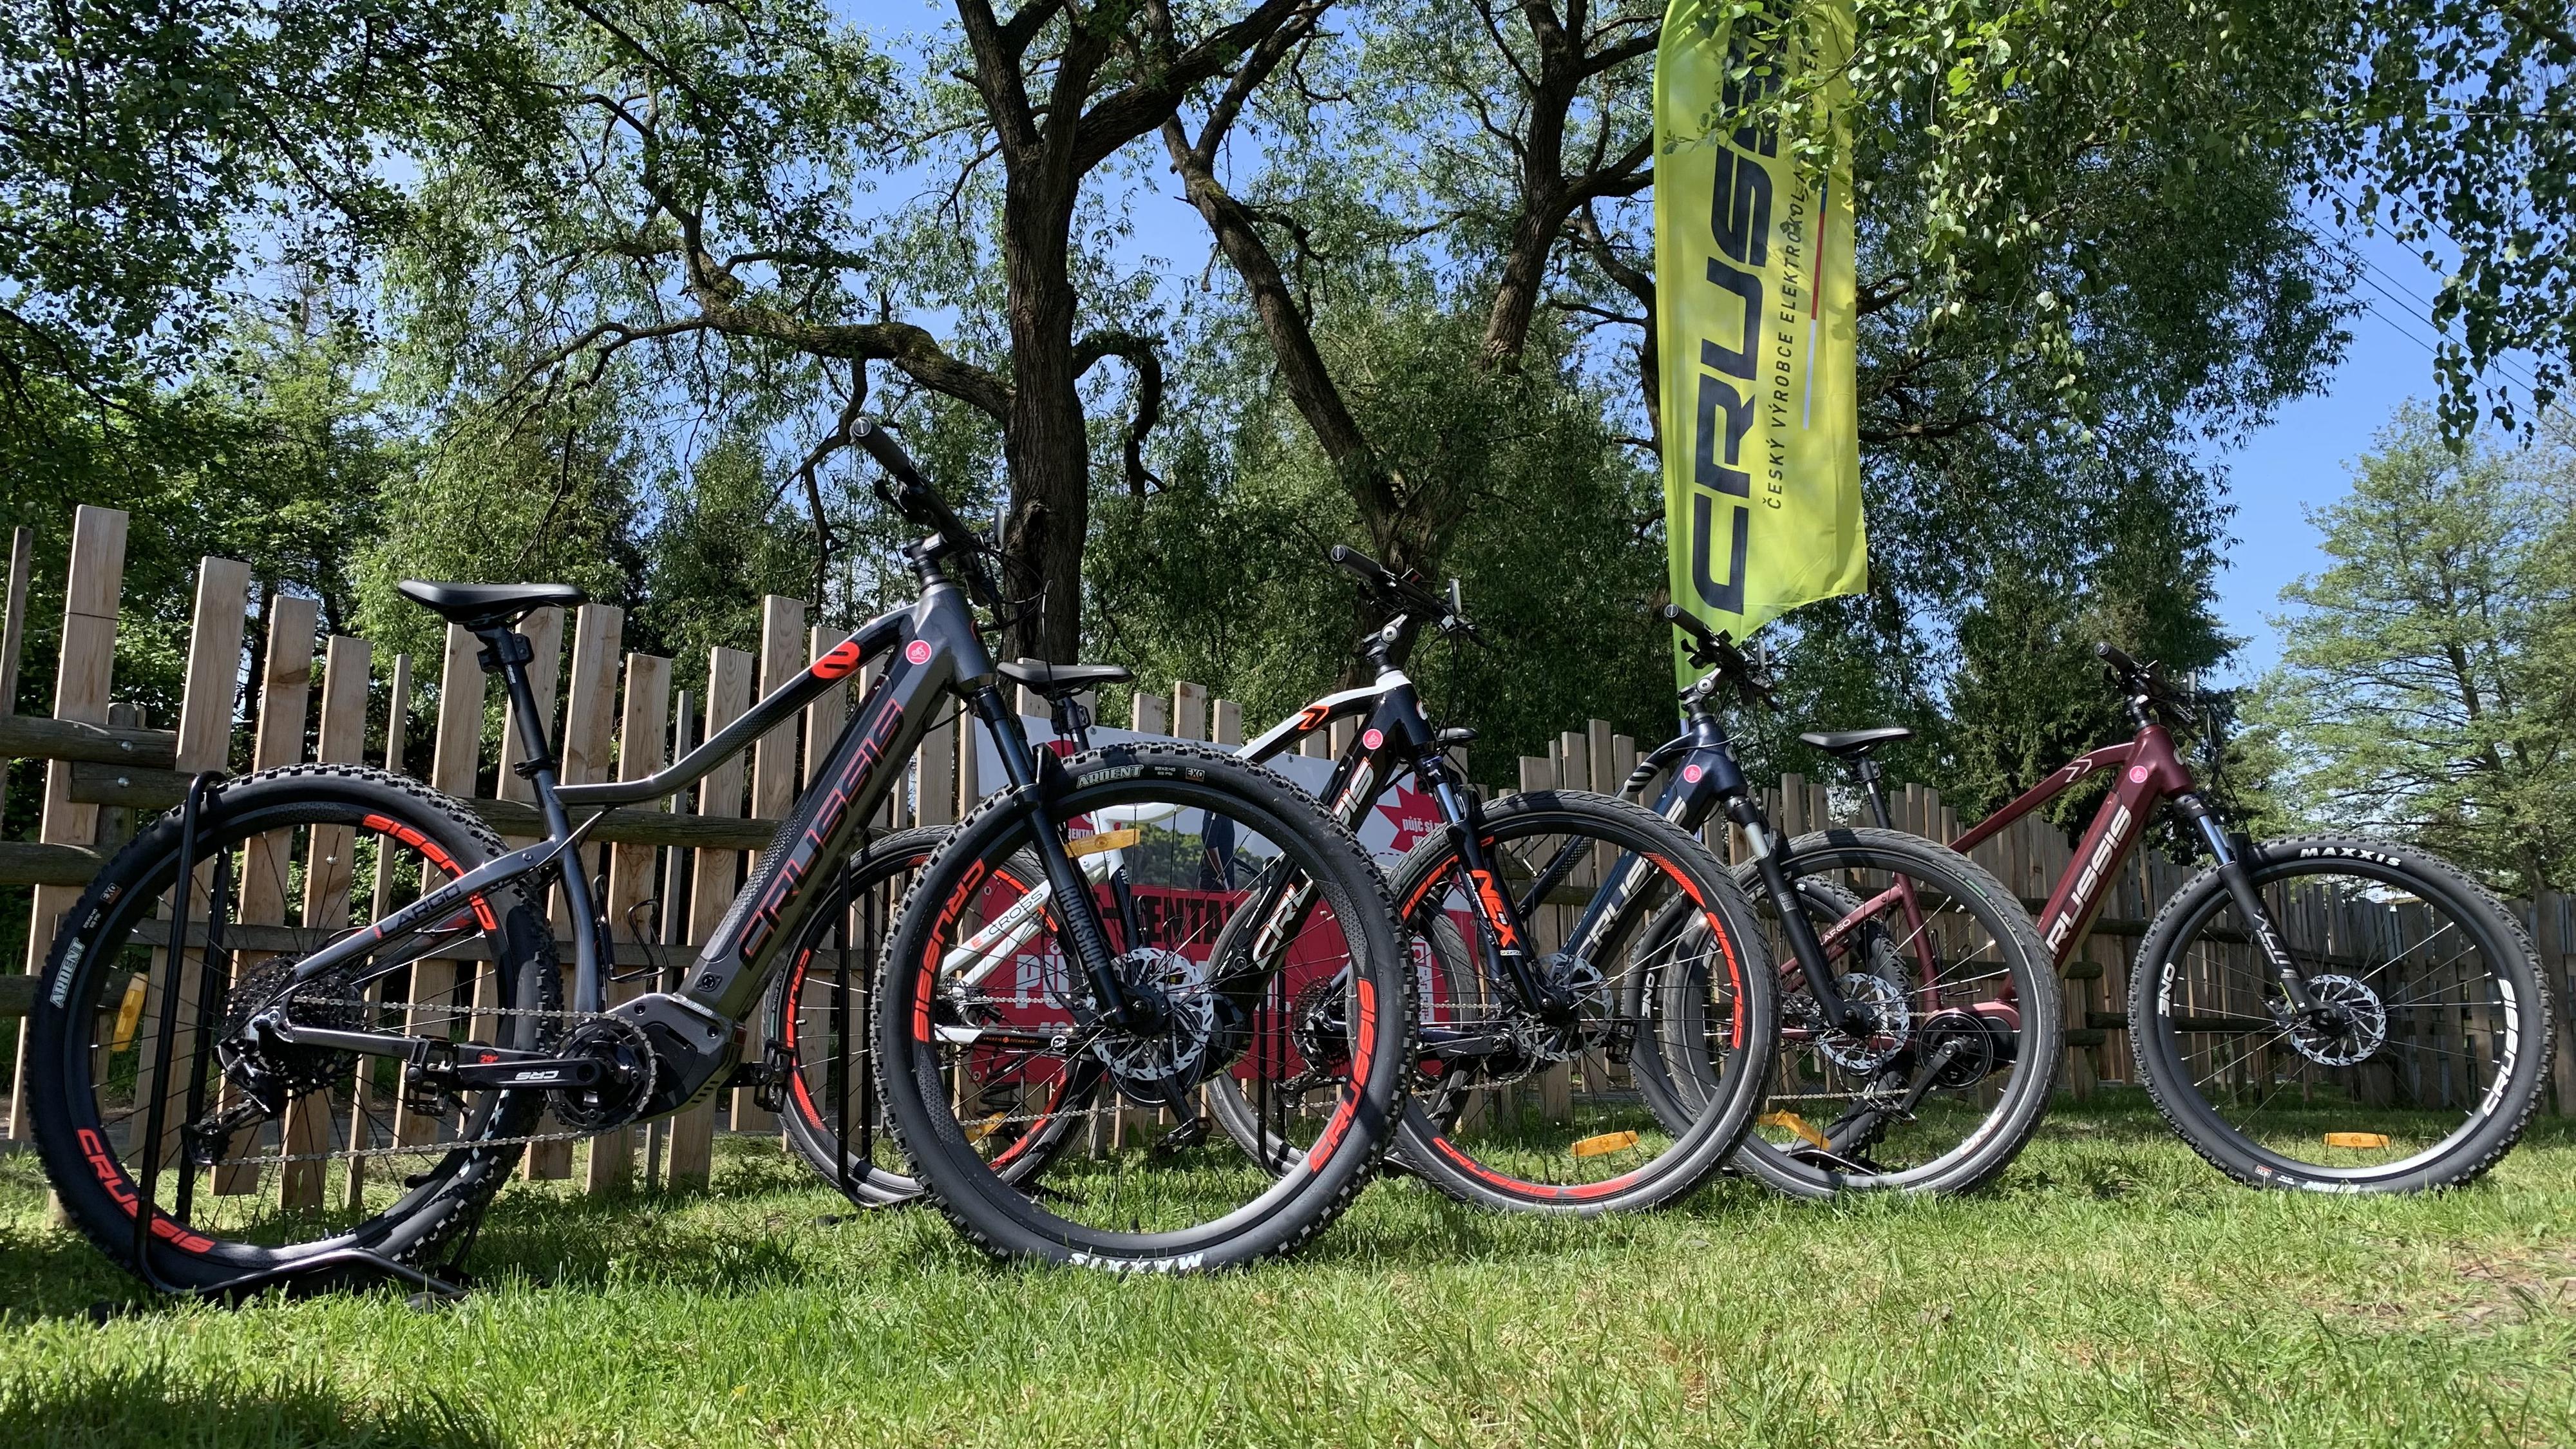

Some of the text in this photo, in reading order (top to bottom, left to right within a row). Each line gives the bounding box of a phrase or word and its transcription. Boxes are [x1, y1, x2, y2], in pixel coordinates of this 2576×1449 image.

[1780, 192, 1804, 324] ELEKTROKOL
[1768, 332, 1793, 427] VÝROBCE
[1763, 438, 1785, 509] ČESKÝ
[1077, 764, 1144, 789] ARDENT
[738, 697, 904, 967] CRUSSIS
[1402, 815, 1423, 833] půjč
[2300, 847, 2401, 866] MAXXIS
[379, 884, 462, 936] LARGO
[1472, 870, 1520, 948] NEX
[2045, 804, 2132, 960] RUSSIS
[914, 858, 985, 1043] CRUSSIS
[971, 891, 1043, 949] E-CROSS
[1823, 919, 1852, 944] ARGO
[50, 937, 85, 1008] ARDENT
[786, 948, 811, 1048] CRUSSI
[1642, 972, 1656, 1019] ONE
[1707, 912, 1744, 1049] CRUSSIS
[2159, 962, 2176, 1018] ONE
[515, 1070, 559, 1080] CRS
[1309, 979, 1375, 1173] CRUSSIS
[2483, 978, 2519, 1117] CRUSSIS
[1959, 1106, 2003, 1155] ONE
[1433, 1137, 1559, 1197] CRUSSIS
